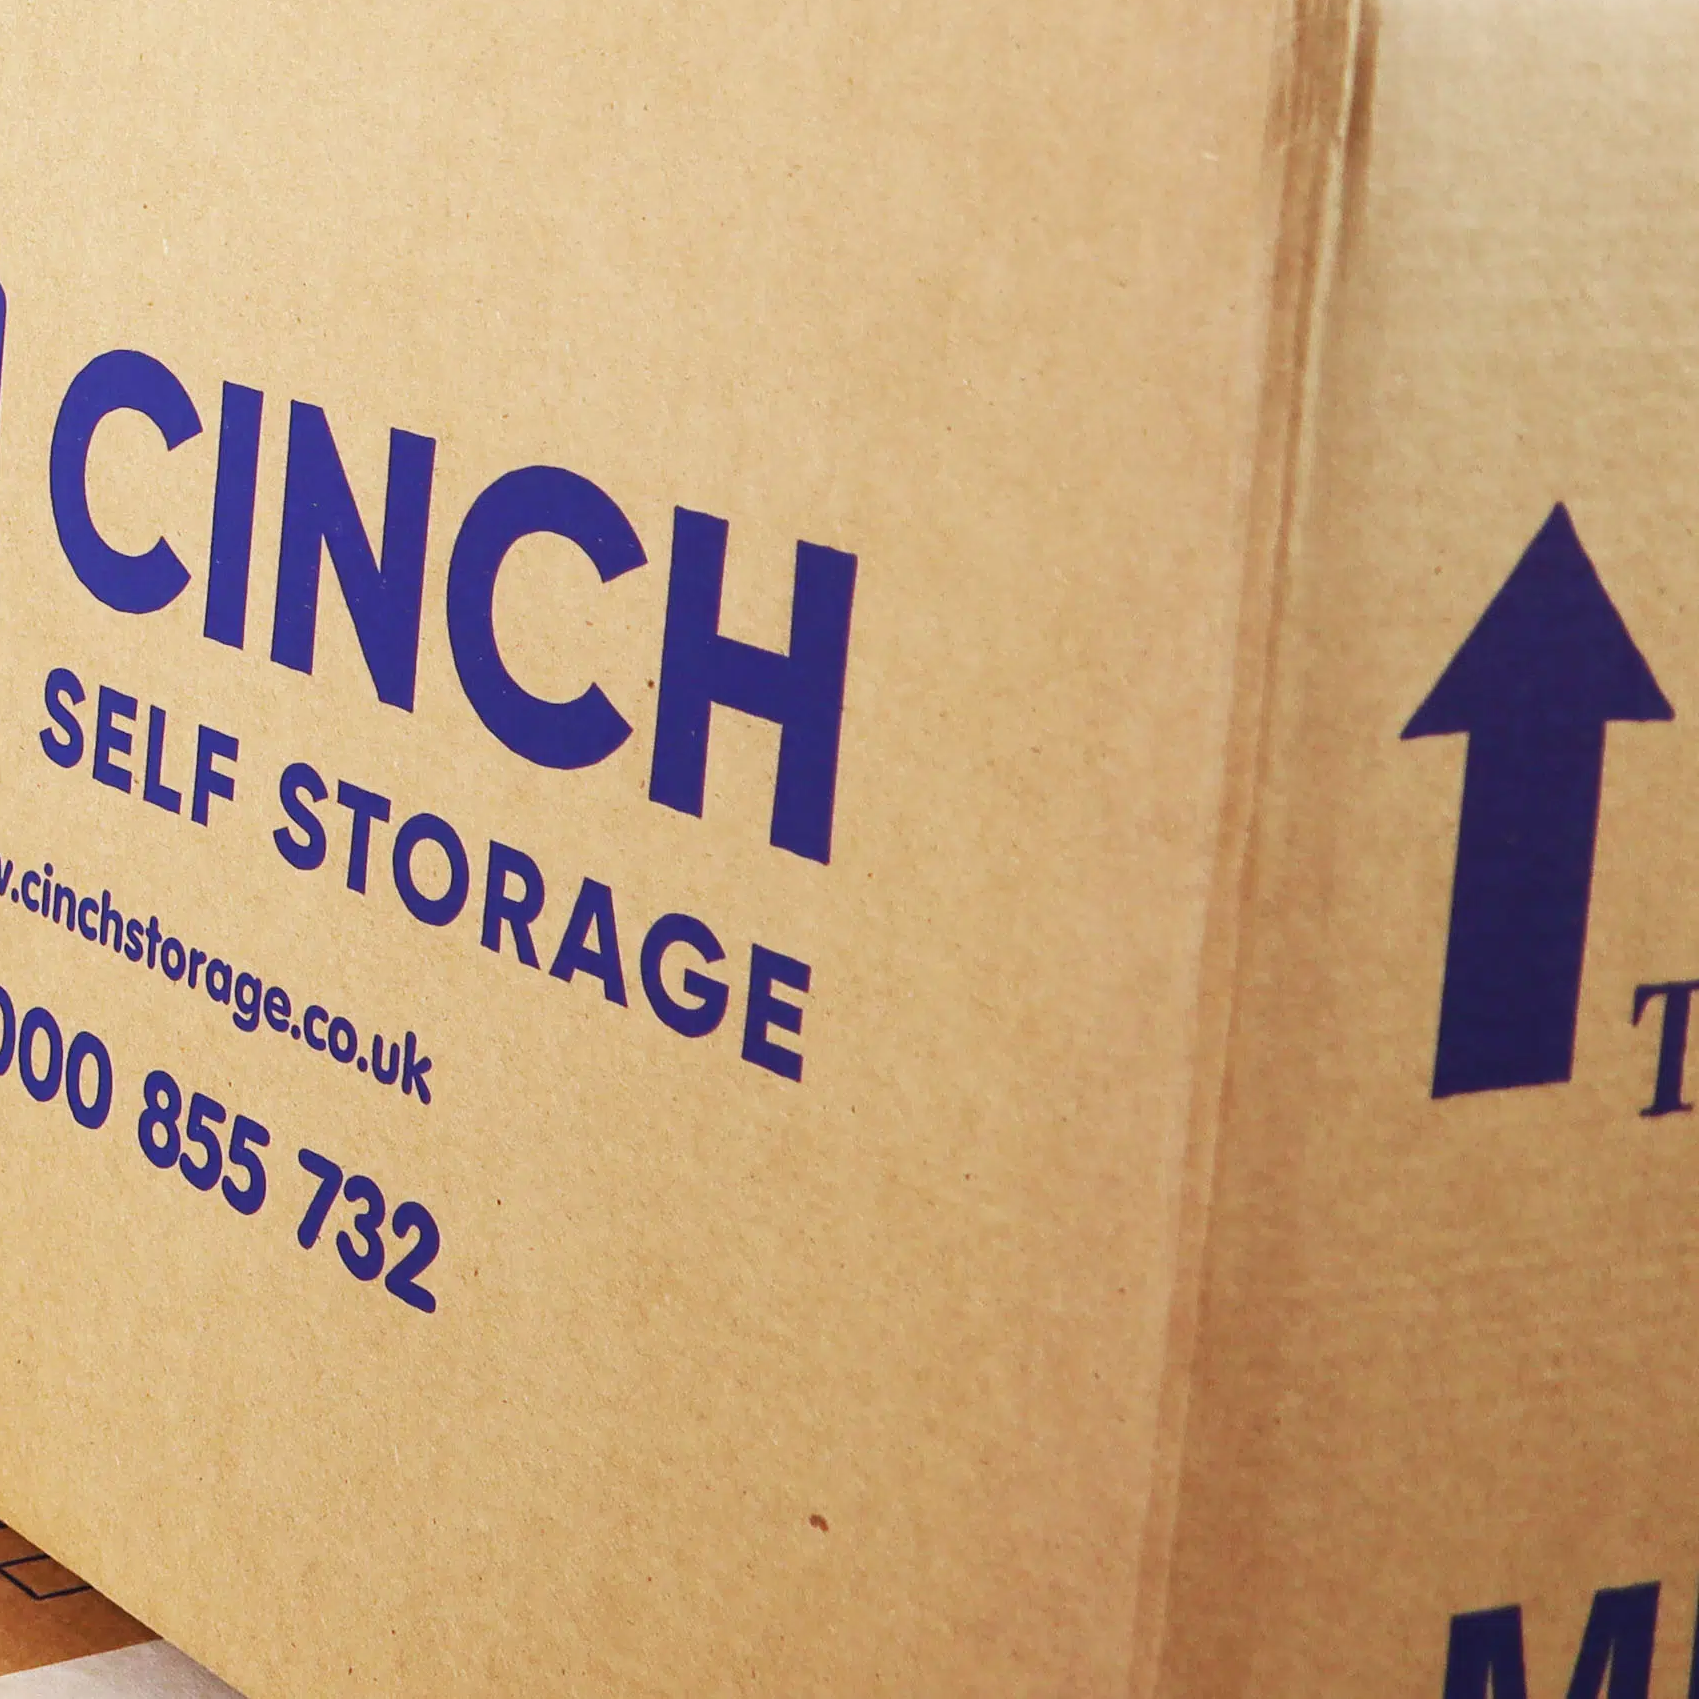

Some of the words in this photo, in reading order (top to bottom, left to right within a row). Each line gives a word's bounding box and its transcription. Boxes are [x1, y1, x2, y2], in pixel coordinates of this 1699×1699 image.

[49, 348, 858, 865] CINCH
[38, 666, 239, 826] SELF
[273, 762, 811, 1082] STORAGE
[137, 1069, 270, 1215] 855
[296, 1148, 440, 1313] 732
